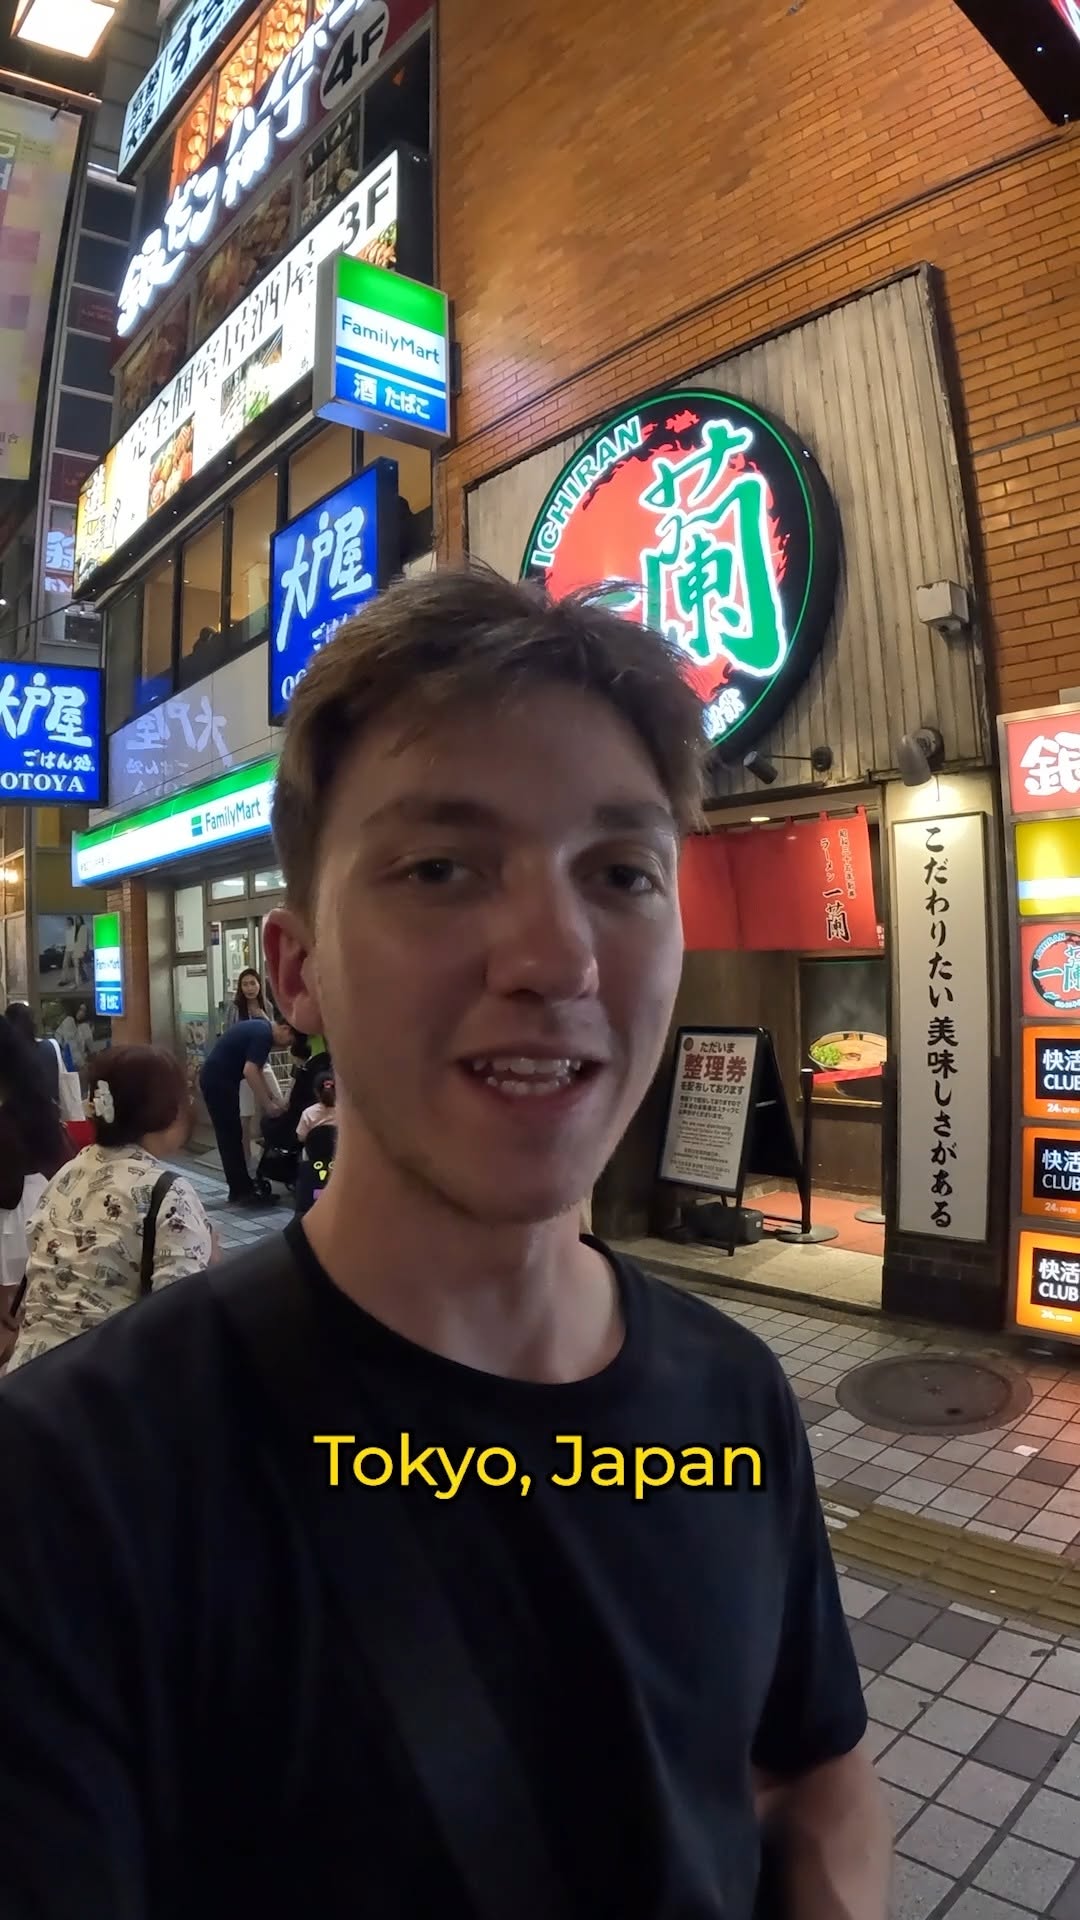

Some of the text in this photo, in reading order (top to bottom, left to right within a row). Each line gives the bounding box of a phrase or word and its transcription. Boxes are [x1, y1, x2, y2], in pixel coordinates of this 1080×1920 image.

[324, 12, 385, 97] 4F
[336, 167, 393, 253] 3F
[341, 313, 441, 365] FamilyMart
[353, 372, 431, 420] 酒 たばこ
[531, 414, 642, 568] ICHIRAN
[275, 505, 373, 653] 大戸屋
[0, 771, 85, 793] OTOYA
[205, 800, 261, 833] FamilyMart
[820, 838, 835, 882] ラーメン
[822, 887, 851, 942] 一蘭
[923, 825, 960, 1230] こだわりたい美味しさがある
[699, 1042, 737, 1054] ただいま
[1042, 1049, 1080, 1072] 快活
[683, 1053, 748, 1083] 整理券
[1041, 1149, 1080, 1173] 快活
[1042, 1173, 1080, 1191] CLUB
[1038, 1258, 1080, 1284] 快活
[1038, 1281, 1079, 1302] CLUB
